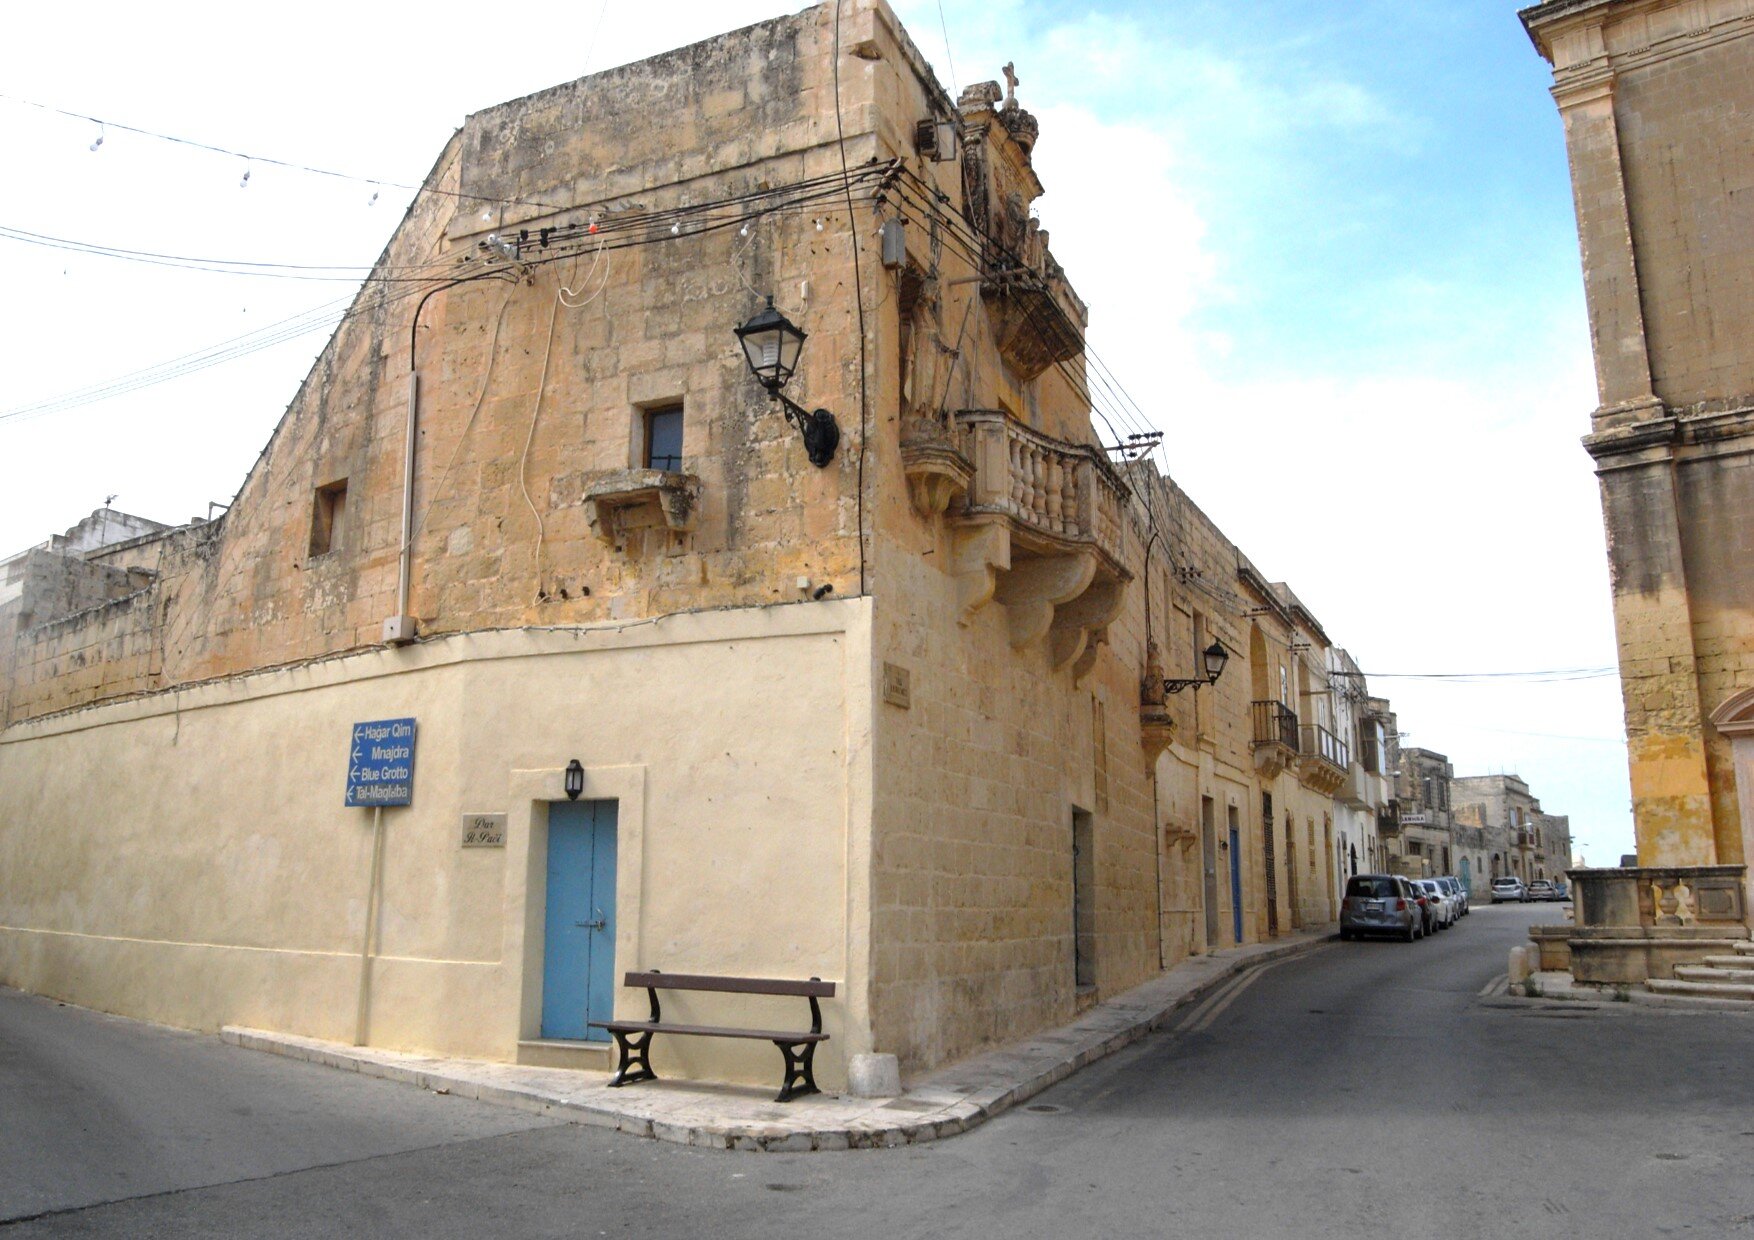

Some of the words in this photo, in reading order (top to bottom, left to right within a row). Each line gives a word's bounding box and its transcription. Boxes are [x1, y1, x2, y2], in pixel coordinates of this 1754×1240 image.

[392, 723, 411, 738] Qim
[371, 744, 410, 763] Mnajdra
[361, 767, 380, 781] Blue
[381, 766, 409, 780] Grotto
